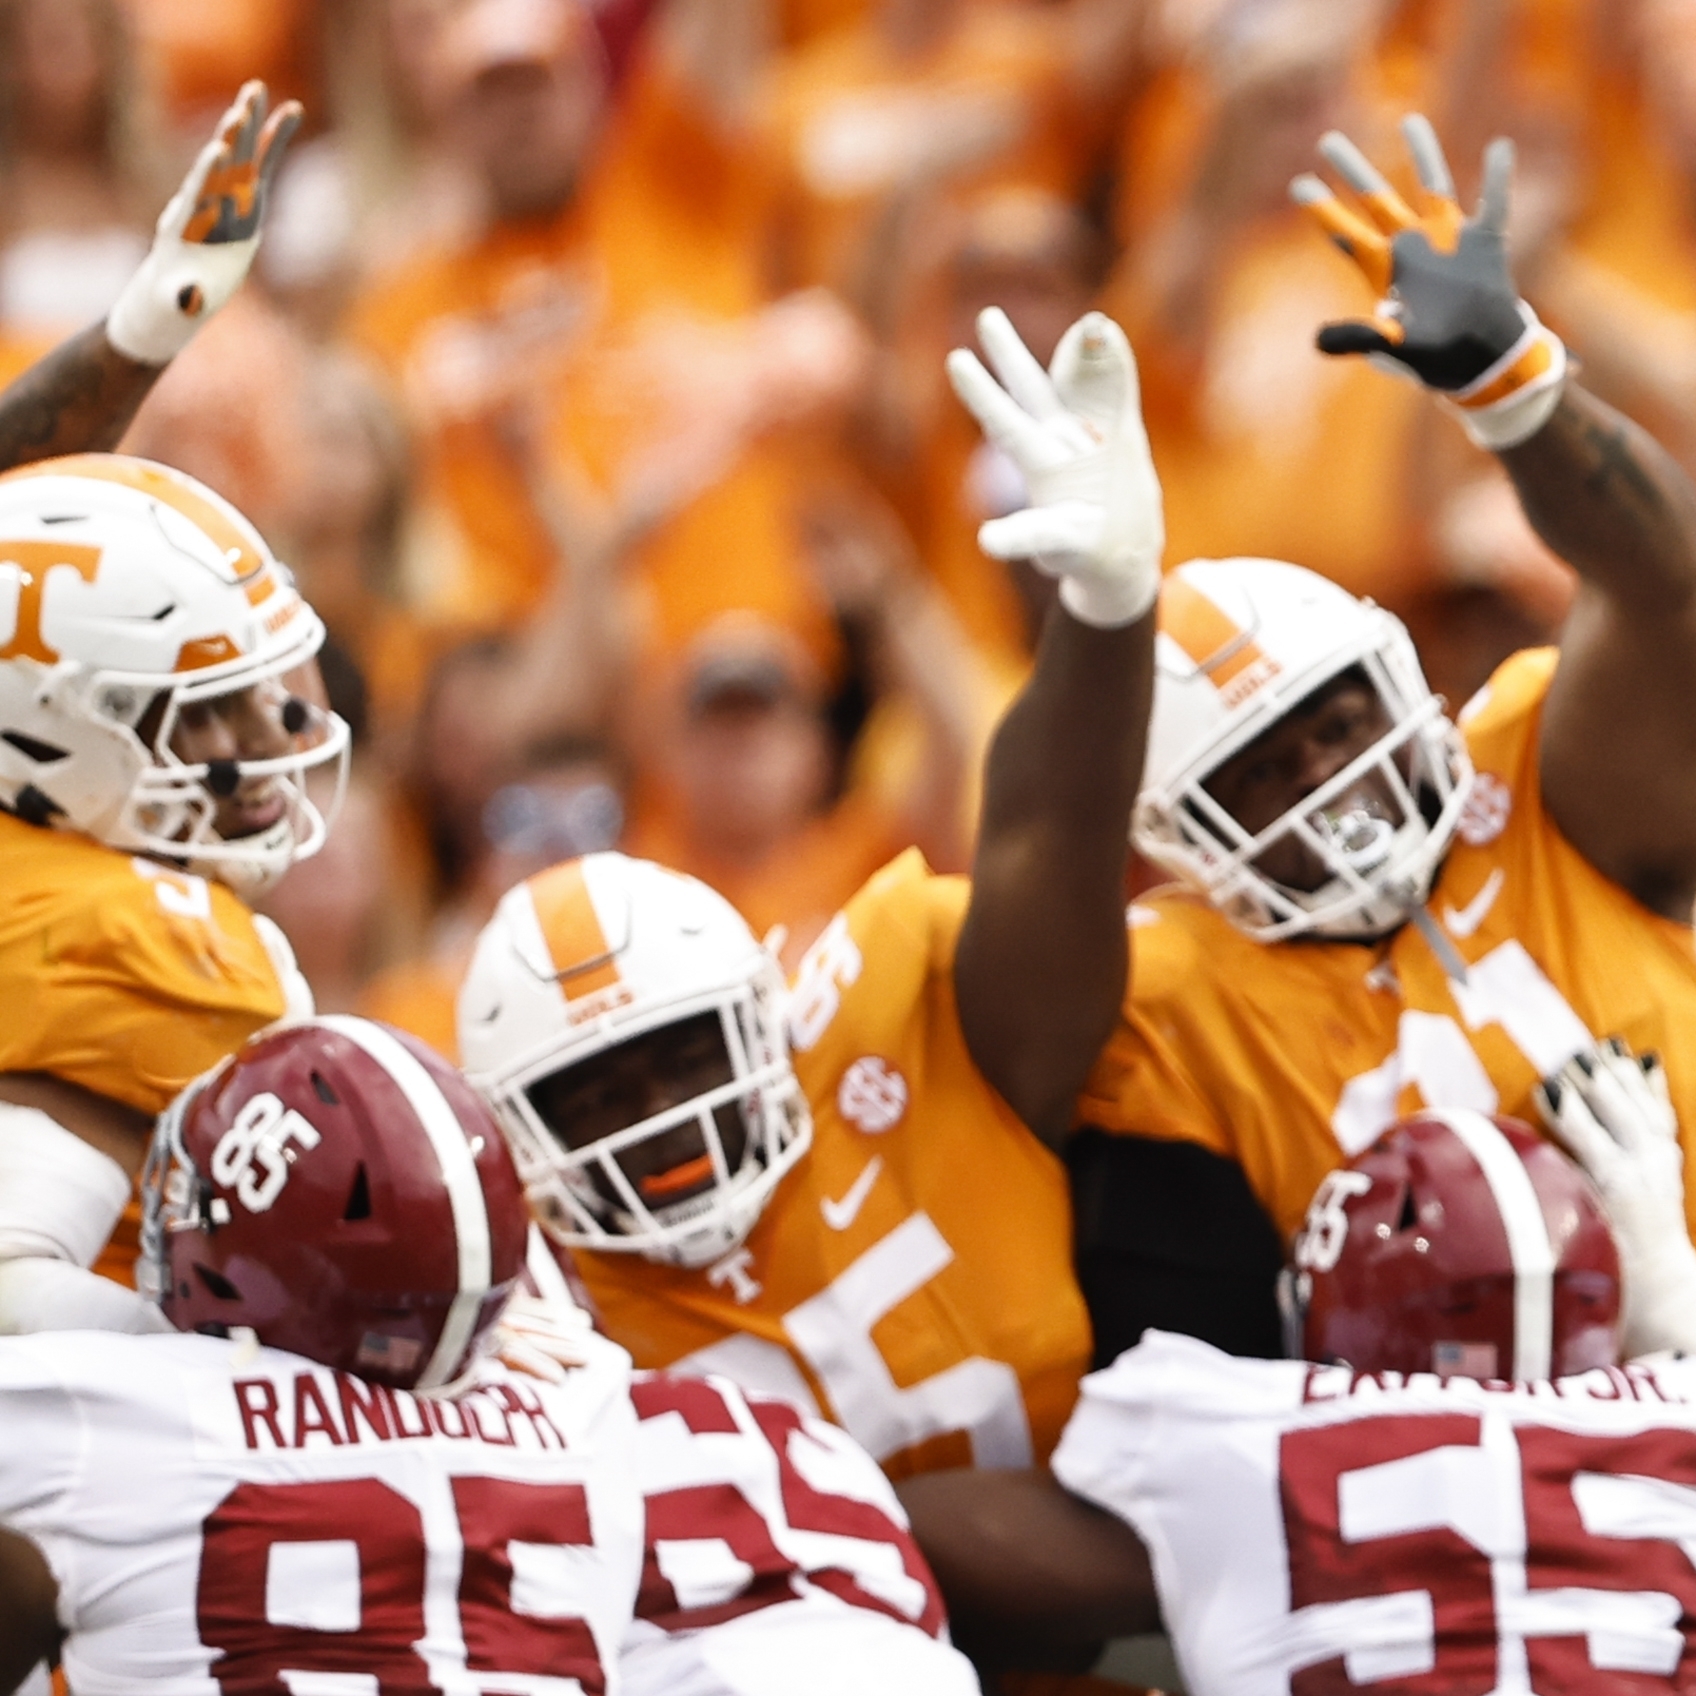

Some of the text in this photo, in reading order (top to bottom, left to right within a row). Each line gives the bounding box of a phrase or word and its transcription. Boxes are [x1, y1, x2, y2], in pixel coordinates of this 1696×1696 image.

[0, 539, 103, 664] T
[211, 1092, 322, 1213] 85
[1295, 1169, 1372, 1273] 55
